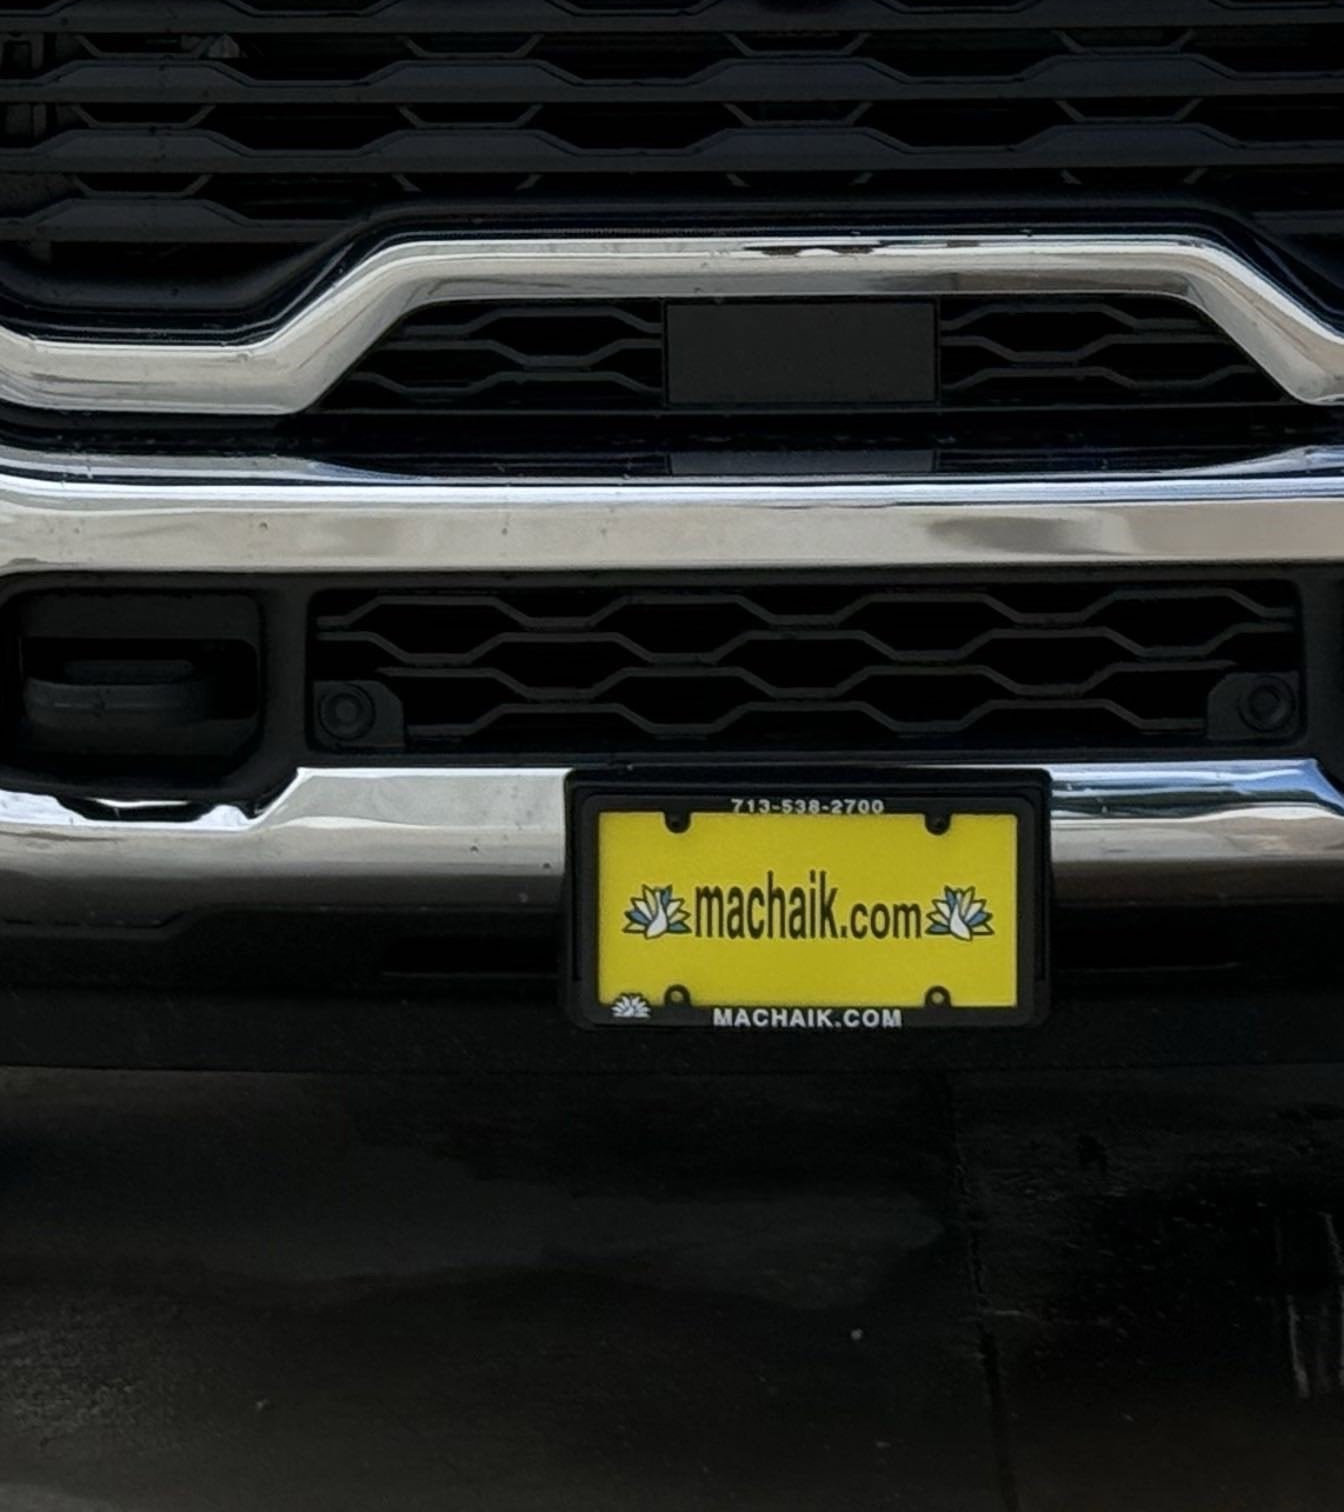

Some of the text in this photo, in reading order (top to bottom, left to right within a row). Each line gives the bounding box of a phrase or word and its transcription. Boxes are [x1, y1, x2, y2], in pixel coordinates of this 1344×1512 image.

[730, 798, 885, 815] 713-538-2700
[695, 869, 922, 940] machaik.com
[712, 1007, 903, 1028] MACHAIK.COM
